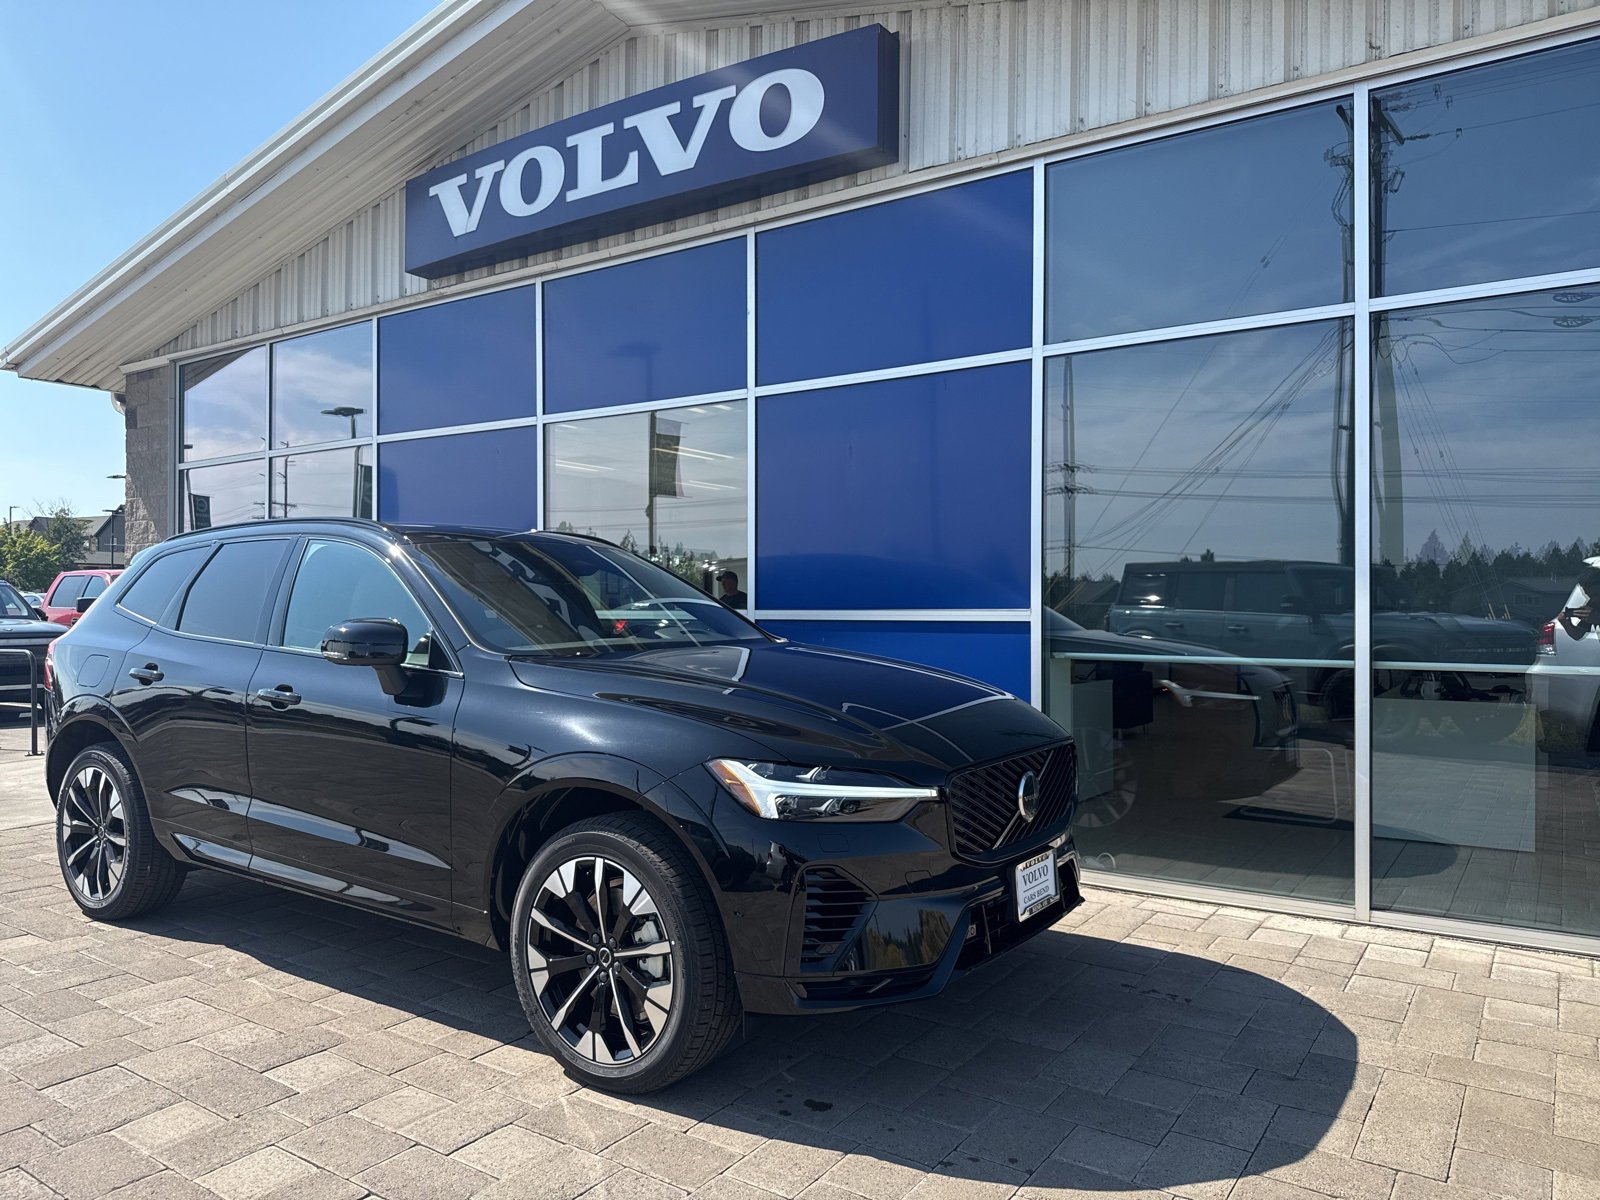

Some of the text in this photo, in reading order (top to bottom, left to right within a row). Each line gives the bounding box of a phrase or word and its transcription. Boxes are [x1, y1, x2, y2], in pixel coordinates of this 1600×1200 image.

[429, 68, 825, 238] VOLVO
[1022, 864, 1048, 886] VOLVO
[1023, 885, 1050, 905] CARS BEND
